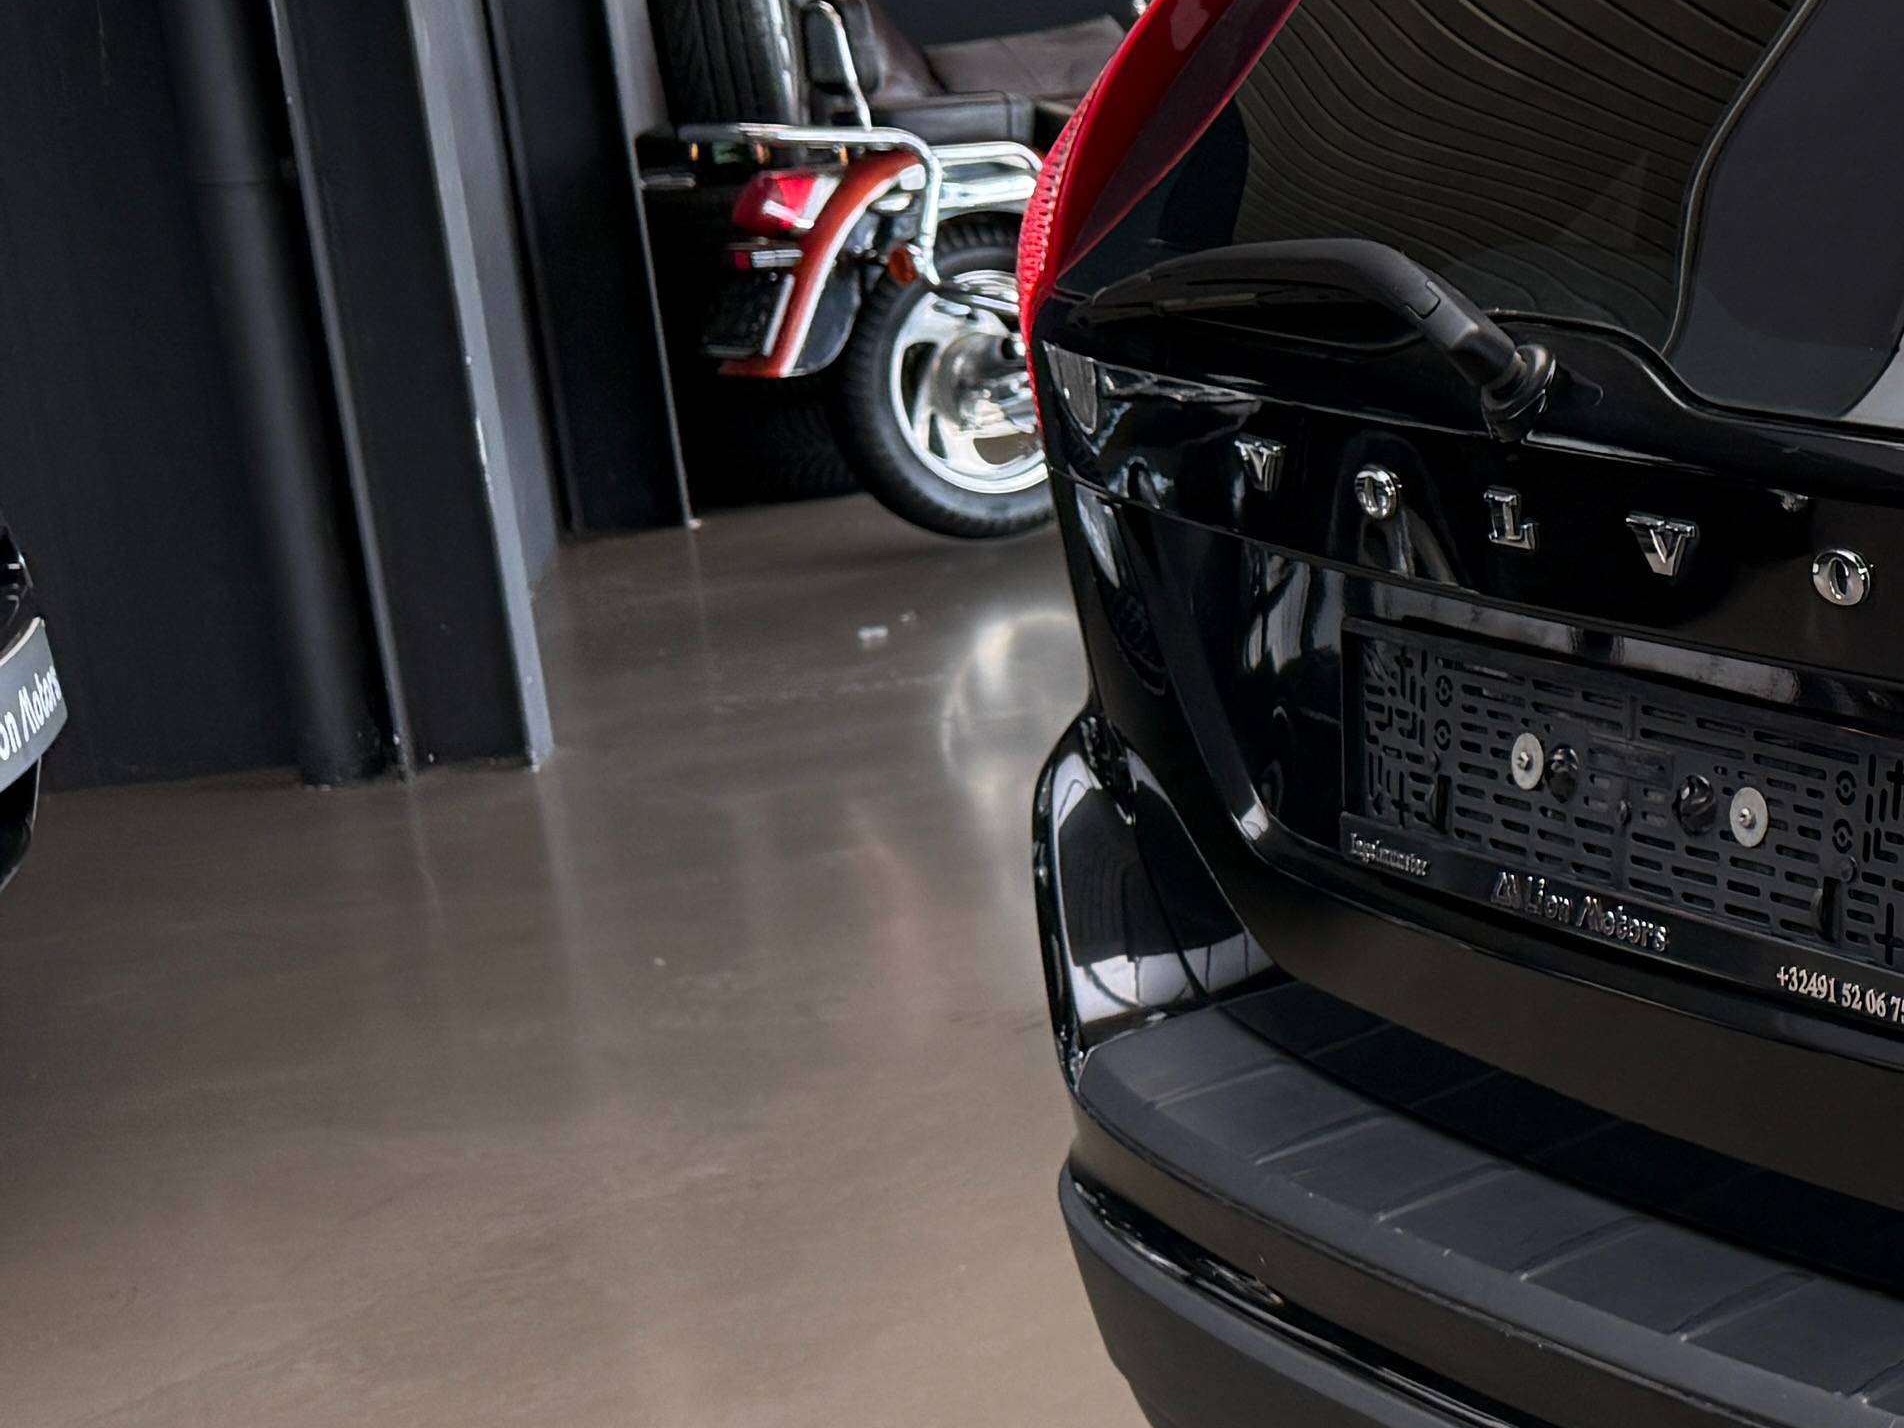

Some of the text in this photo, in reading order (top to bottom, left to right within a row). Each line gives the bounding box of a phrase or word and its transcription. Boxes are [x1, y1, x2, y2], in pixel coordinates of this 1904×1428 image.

[1234, 432, 1872, 607] VOLVO
[1524, 875, 1669, 952] Lion Motors
[1776, 966, 1836, 1003] +32491
[1841, 982, 1862, 1011] 52
[1865, 988, 1886, 1018] 06
